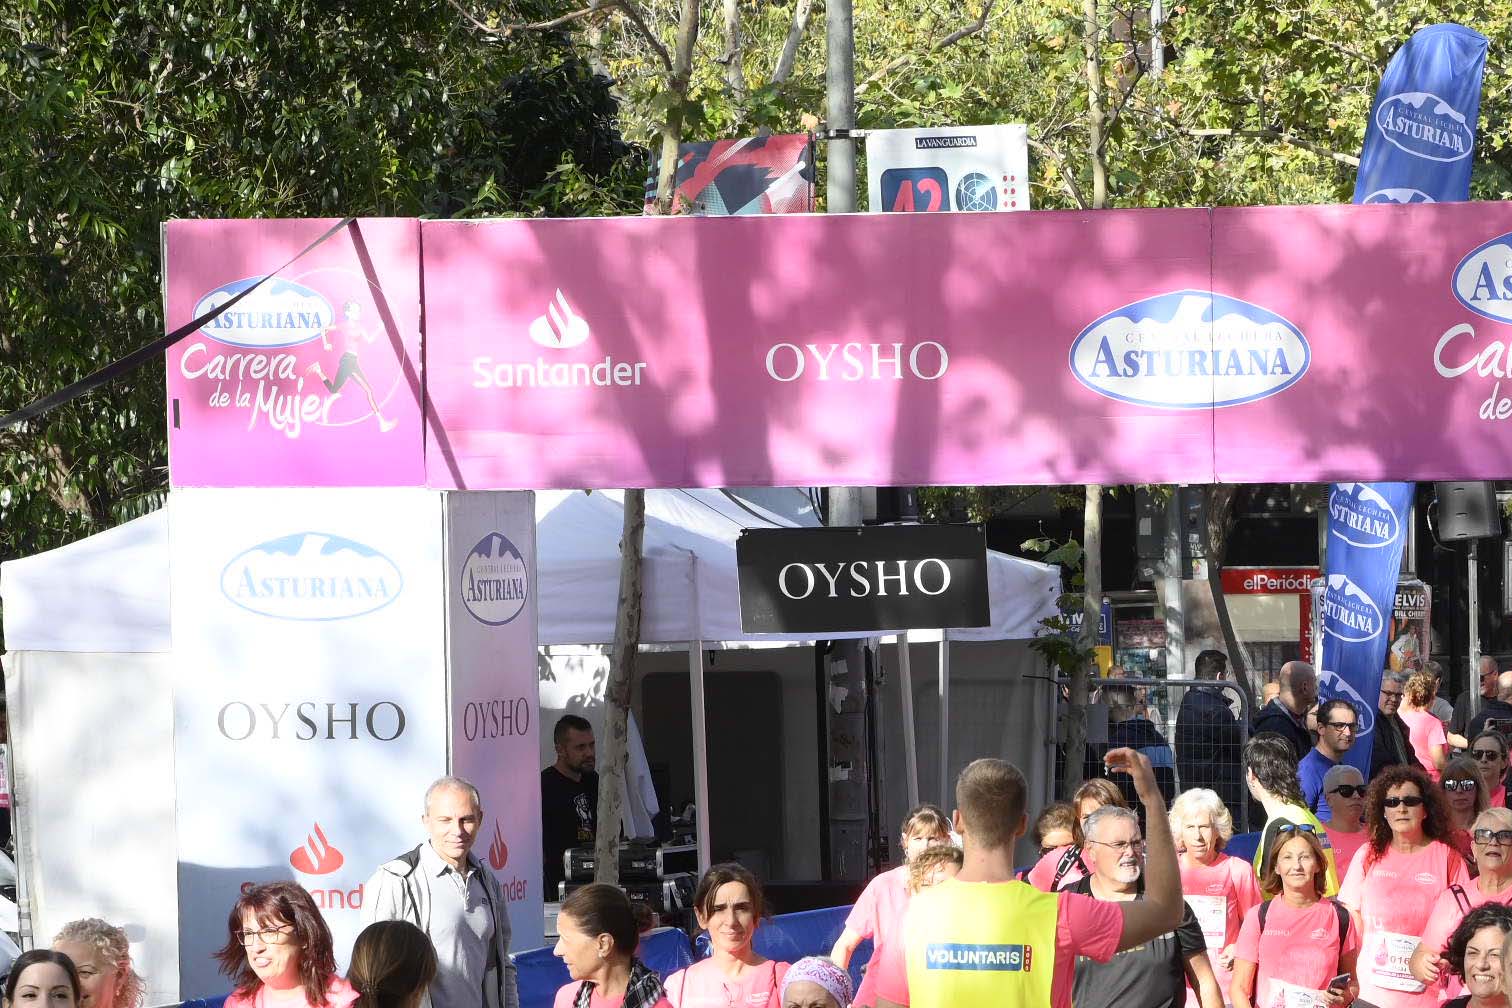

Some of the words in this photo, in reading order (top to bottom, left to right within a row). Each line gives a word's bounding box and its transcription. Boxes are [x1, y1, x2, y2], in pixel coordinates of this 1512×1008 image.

[927, 137, 976, 147] VANGUARDIA
[203, 302, 323, 329] ASTURIANA
[180, 342, 297, 380] Carrera
[472, 356, 647, 388] Santander
[765, 341, 949, 382] OYSHO
[1089, 335, 1292, 378] ASTURIANA
[209, 382, 230, 407] de
[236, 380, 251, 407] la
[248, 375, 342, 439] Mujer
[235, 565, 390, 600] ASTURIANA
[466, 567, 525, 603] ASTURIANA
[778, 557, 951, 600] OYSHO
[1395, 594, 1425, 607] ELVIS
[217, 700, 406, 741] OYSHO
[463, 697, 530, 742] OYSHO
[927, 950, 1021, 965] VOLUNTARIS
